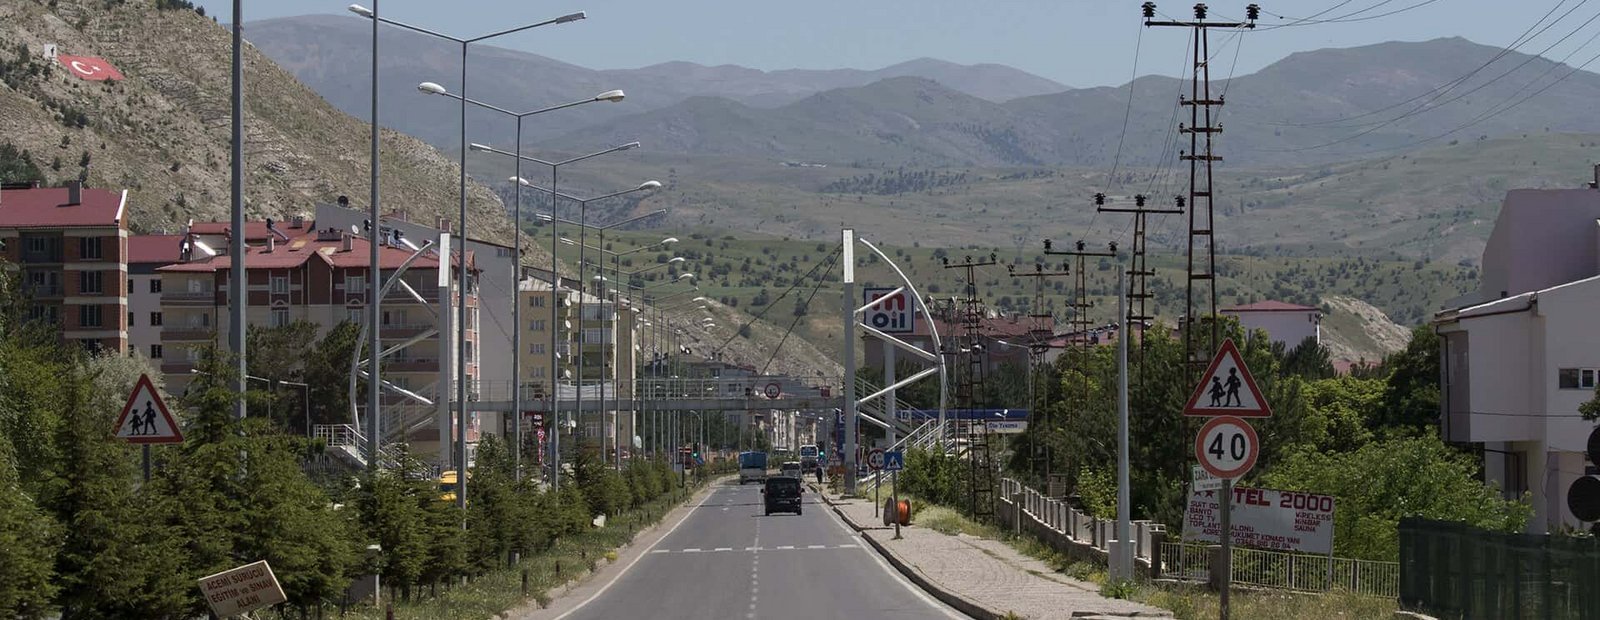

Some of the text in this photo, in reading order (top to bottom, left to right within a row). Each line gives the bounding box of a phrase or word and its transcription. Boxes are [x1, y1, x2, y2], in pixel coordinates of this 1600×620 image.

[1208, 432, 1246, 461] 40
[1230, 487, 1270, 507] TEL
[1280, 492, 1332, 512] 2000
[1188, 520, 1254, 532] TOPLANT ALONU
